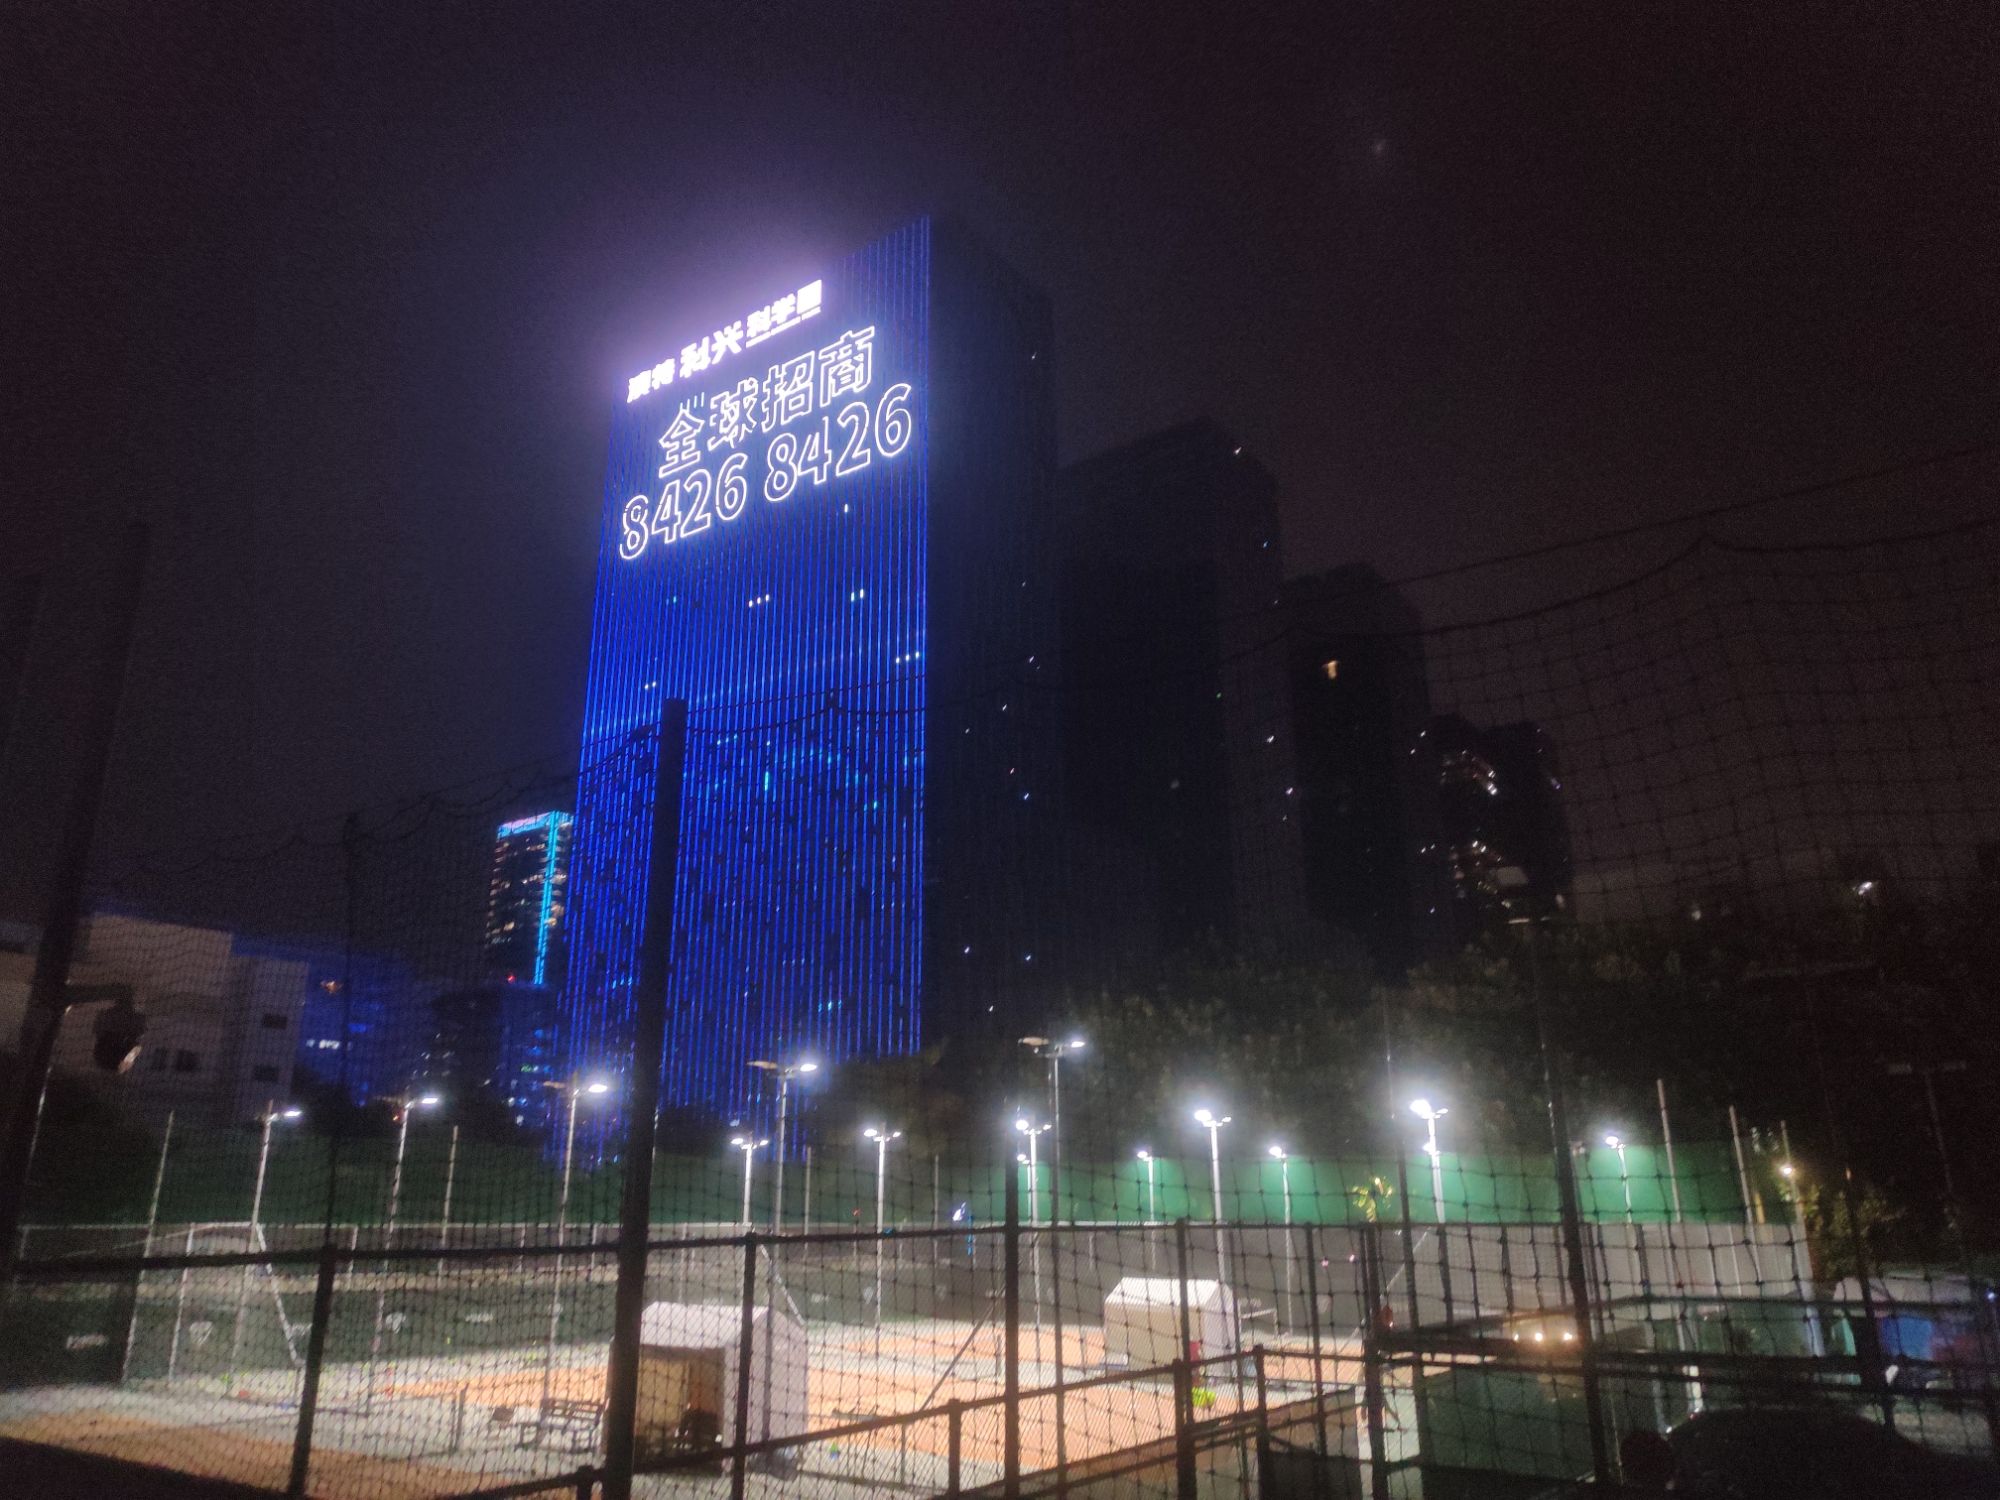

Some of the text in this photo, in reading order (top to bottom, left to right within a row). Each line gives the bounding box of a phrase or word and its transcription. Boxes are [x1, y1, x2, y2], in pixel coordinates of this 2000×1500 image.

[619, 383, 912, 560] 8426 8426
[658, 325, 875, 479] 全球招商
